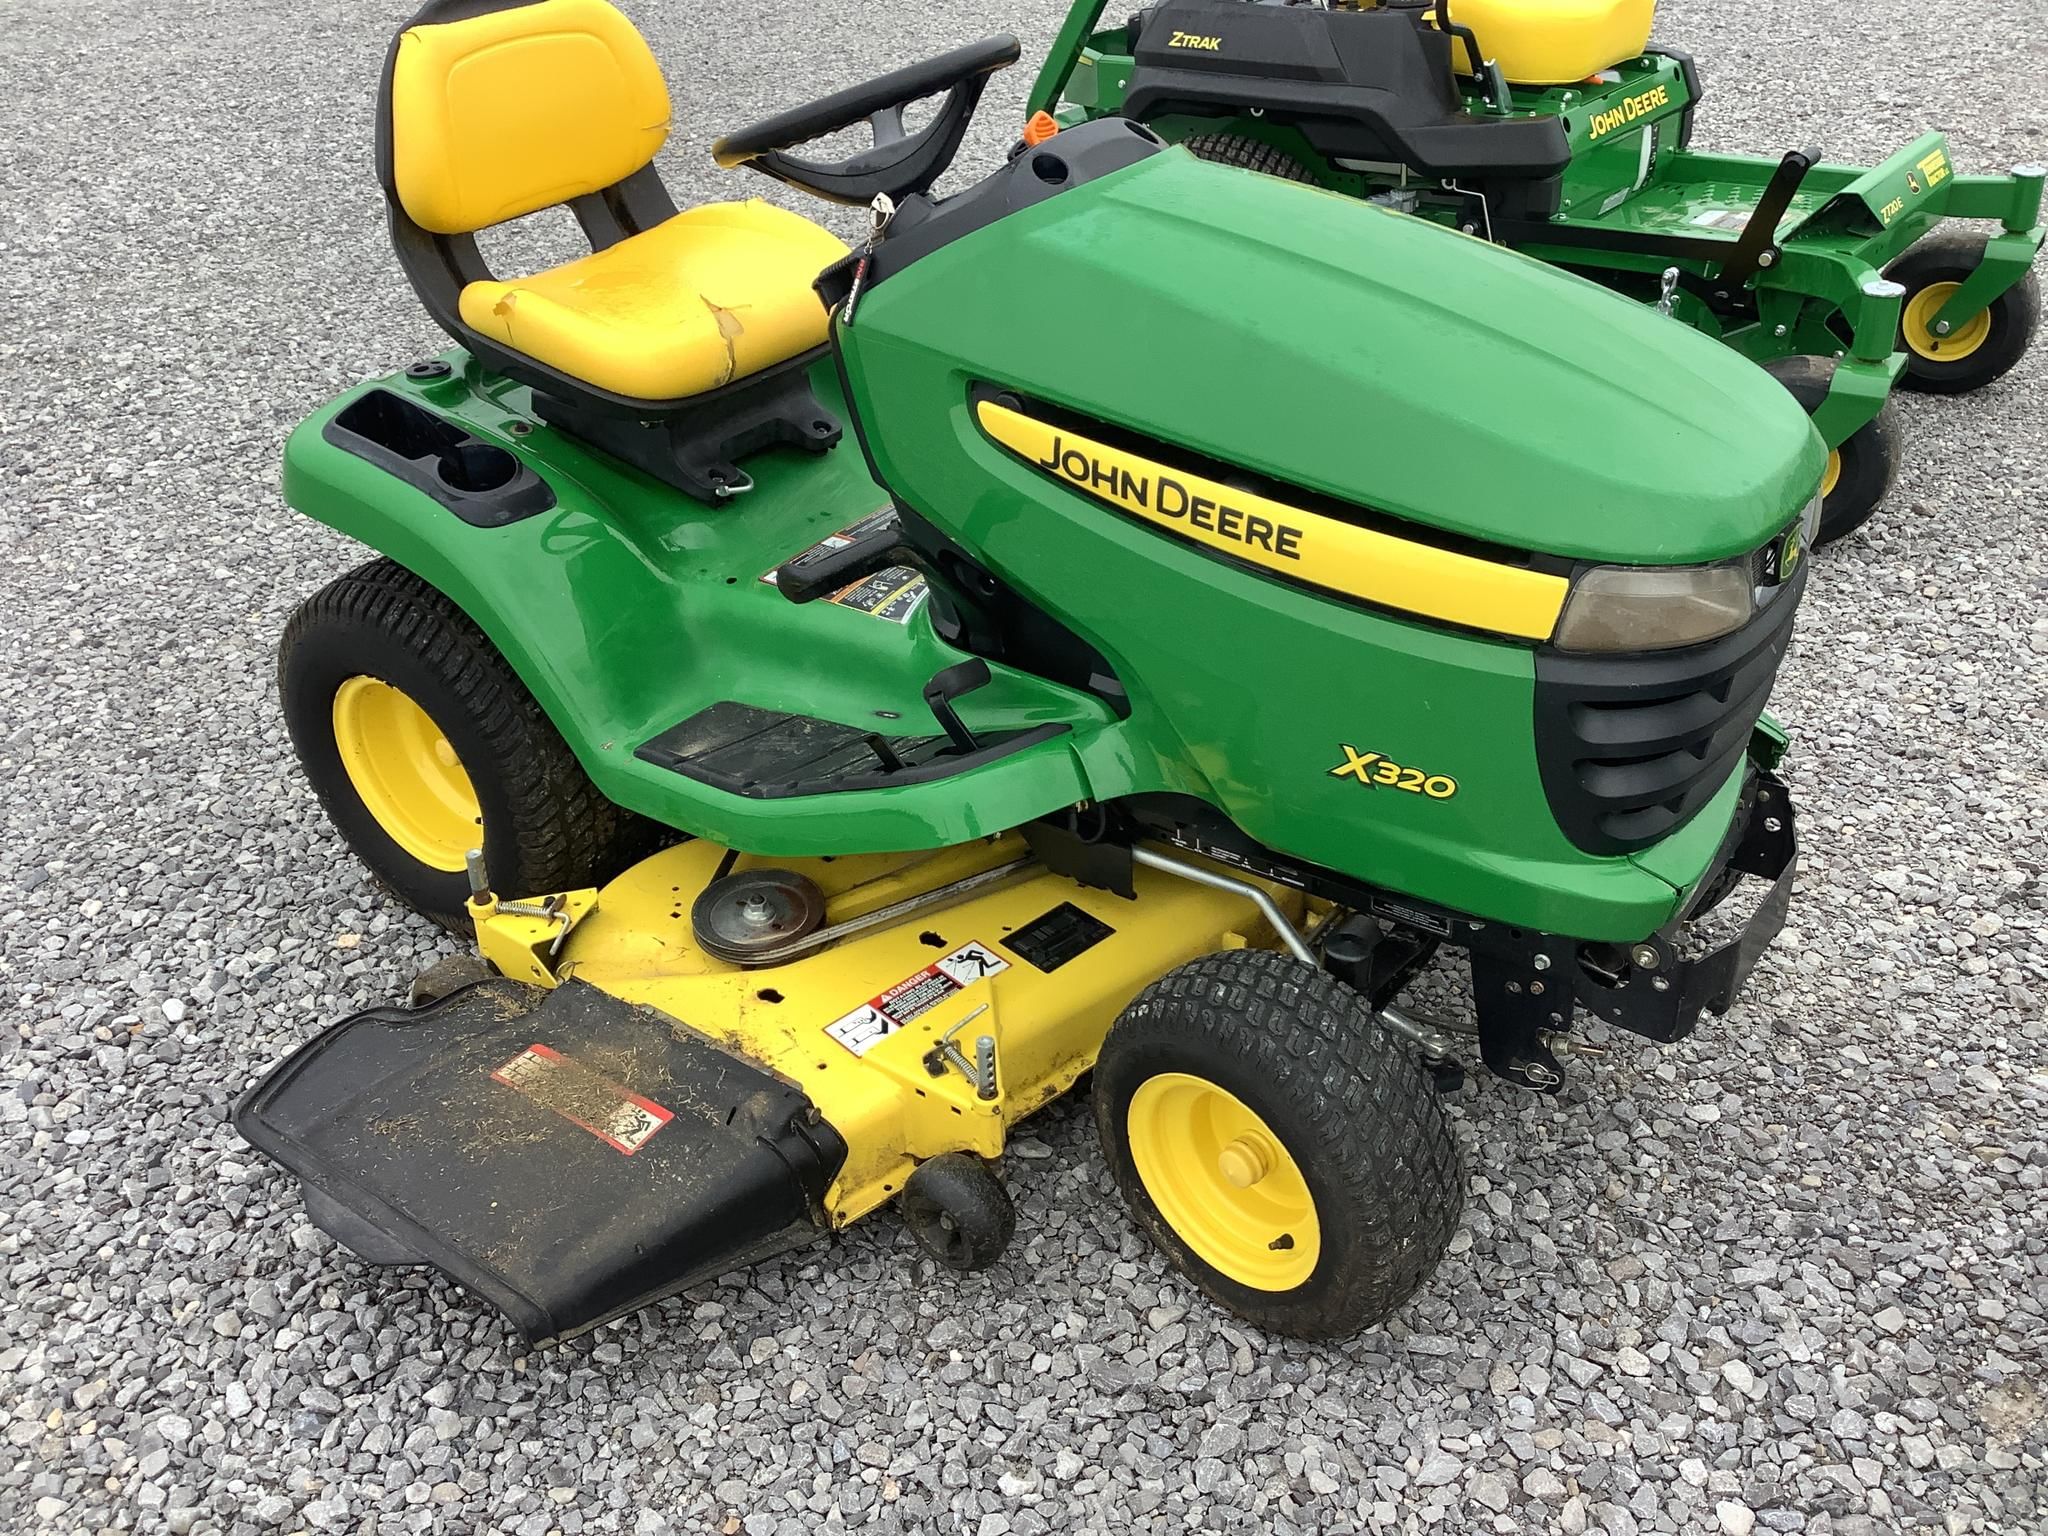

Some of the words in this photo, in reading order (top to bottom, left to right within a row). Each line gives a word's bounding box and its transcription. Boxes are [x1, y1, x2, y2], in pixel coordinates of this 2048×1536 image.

[1168, 31, 1222, 51] ZTRAK
[1589, 106, 1625, 140] JOHN
[1623, 84, 1668, 119] DEERE
[1040, 436, 1149, 508] JOHN
[1156, 475, 1303, 560] DEERE
[1327, 744, 1457, 799] X320
[888, 970, 931, 996] DANGER
